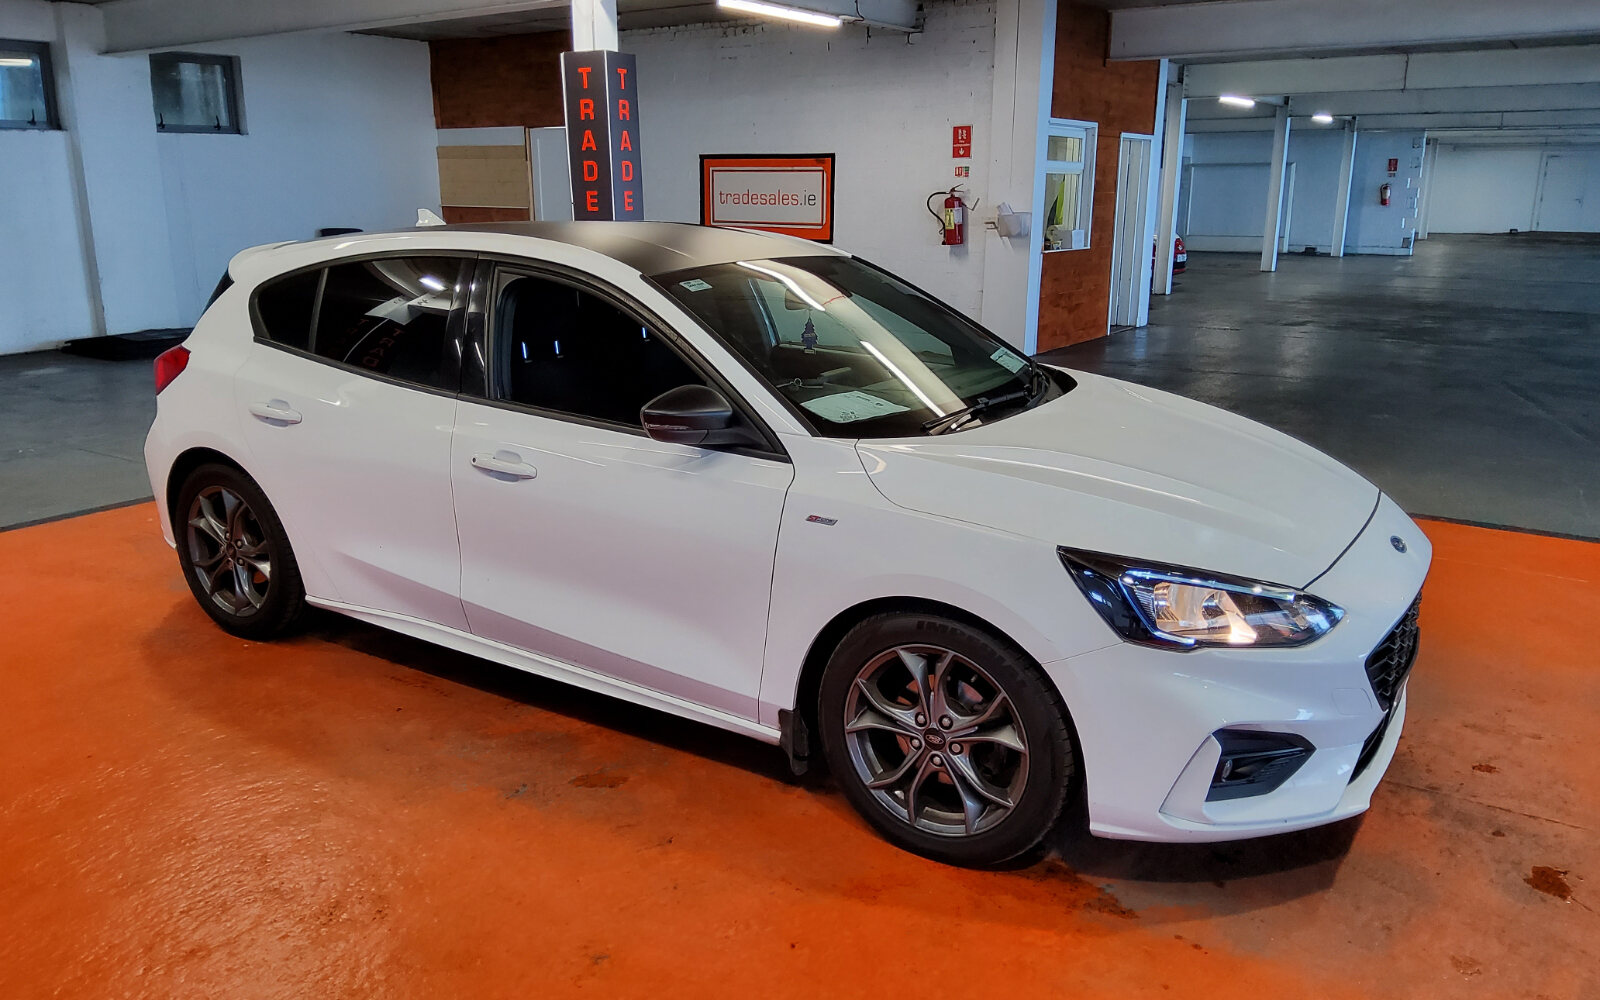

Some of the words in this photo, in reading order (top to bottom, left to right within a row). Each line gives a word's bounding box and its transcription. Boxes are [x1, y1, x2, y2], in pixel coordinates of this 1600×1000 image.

[577, 67, 599, 212] TRADE
[617, 68, 634, 211] TRADE
[719, 189, 817, 206] tradesales.ie
